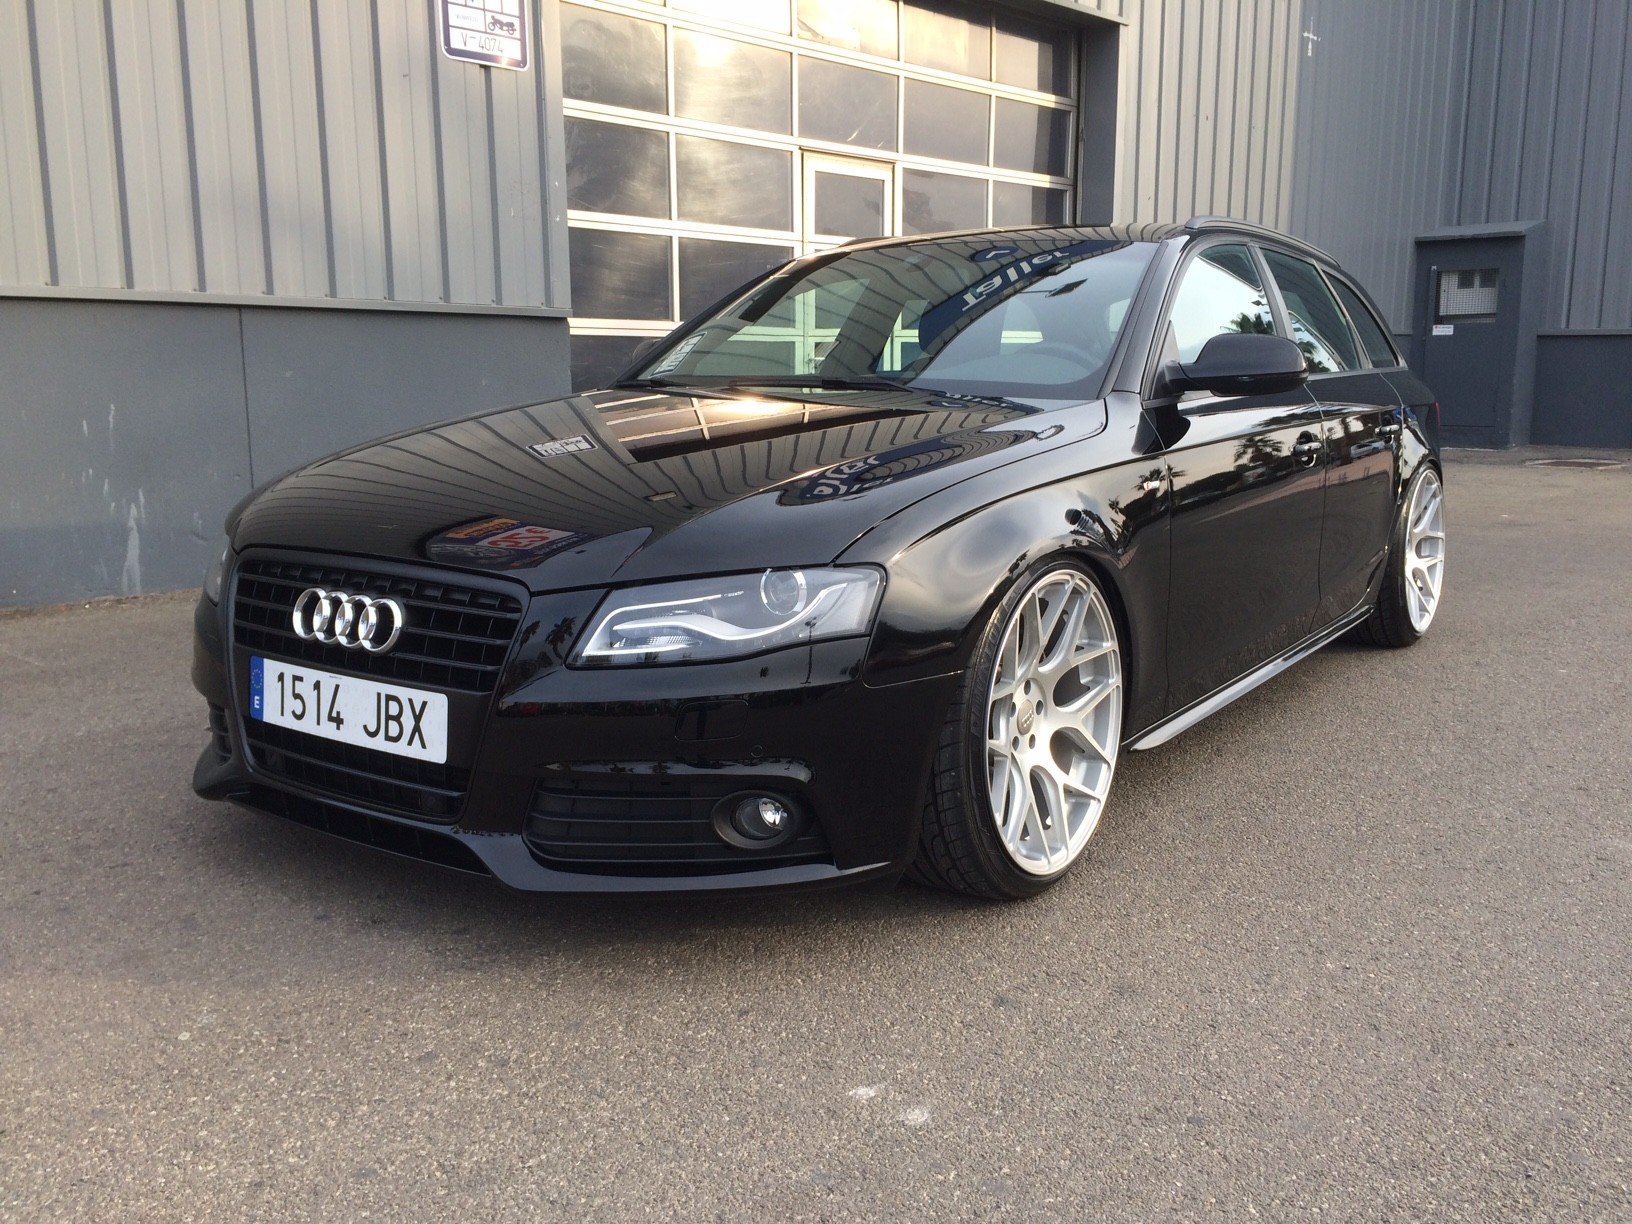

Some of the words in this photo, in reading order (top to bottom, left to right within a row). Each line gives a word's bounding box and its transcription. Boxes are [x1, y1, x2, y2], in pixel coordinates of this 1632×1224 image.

[254, 695, 260, 709] E
[277, 671, 344, 731] 1514
[362, 691, 428, 750] JBX
